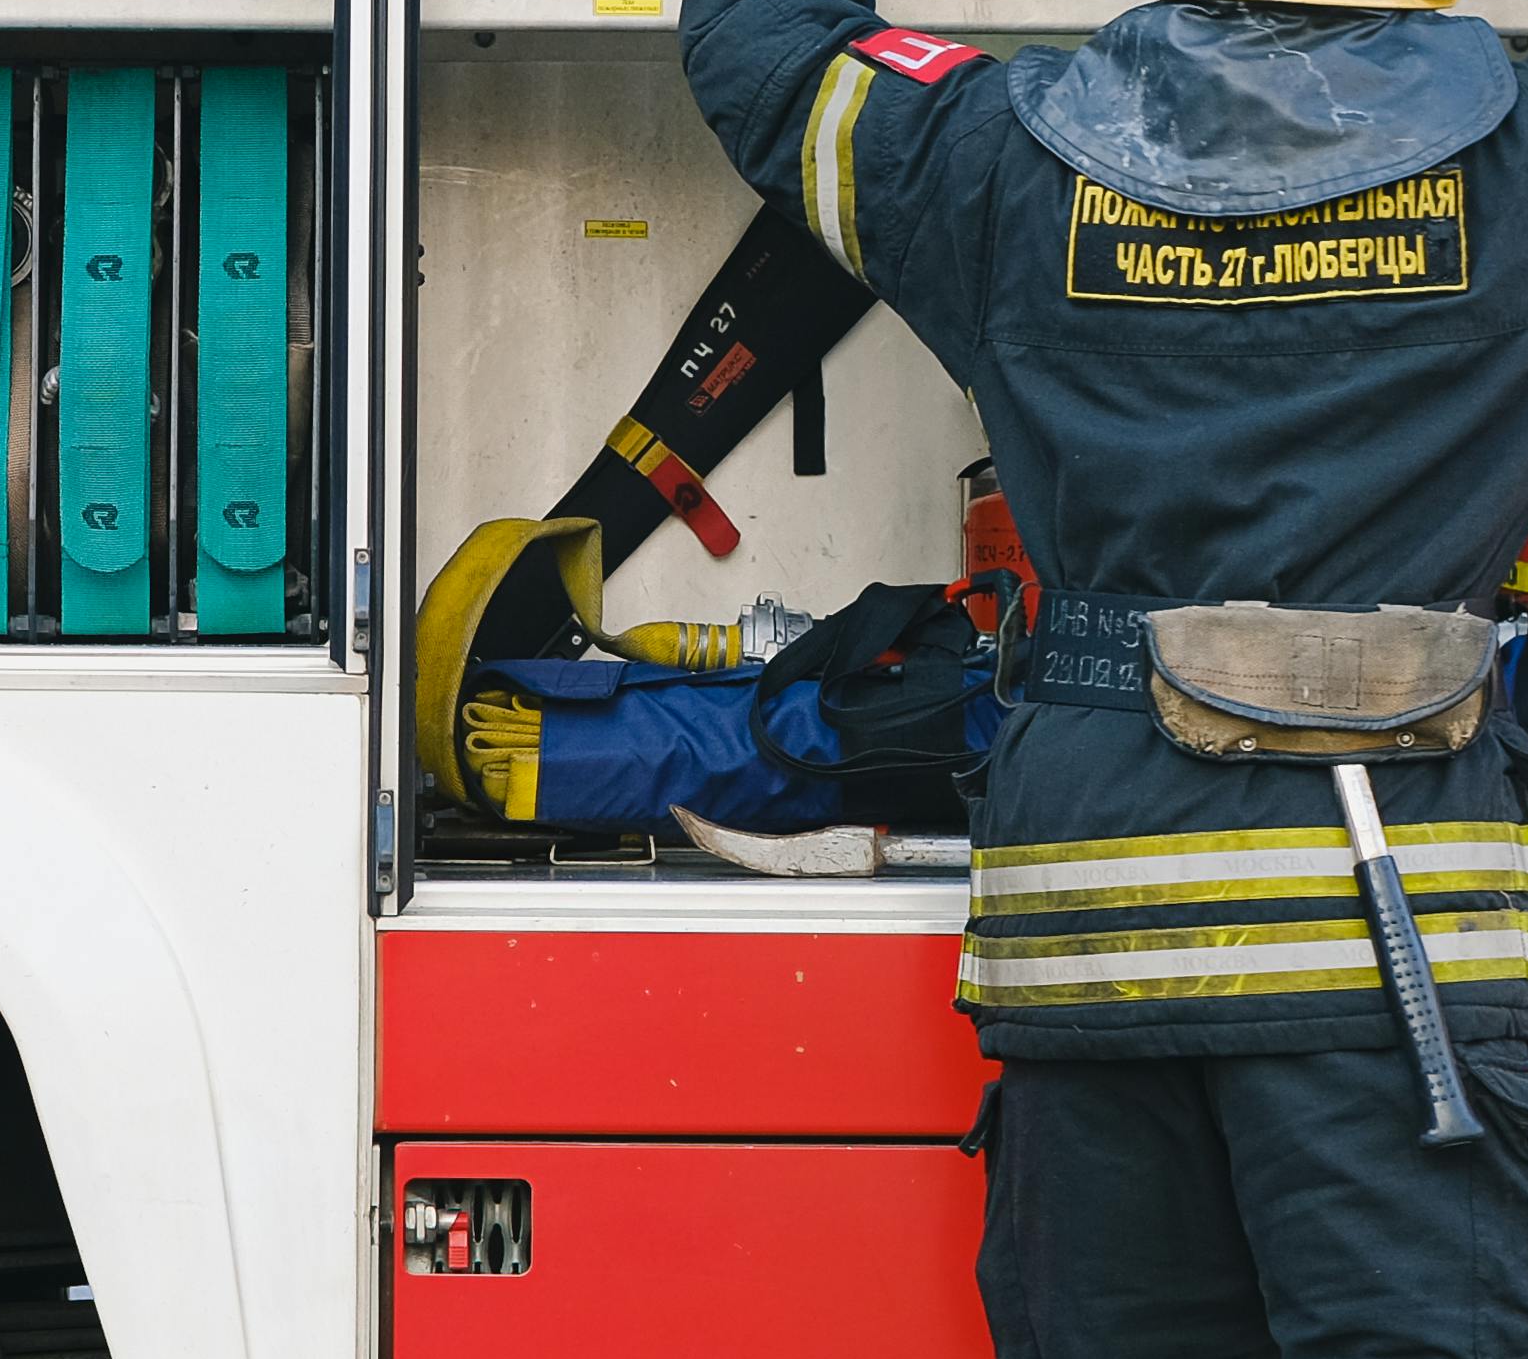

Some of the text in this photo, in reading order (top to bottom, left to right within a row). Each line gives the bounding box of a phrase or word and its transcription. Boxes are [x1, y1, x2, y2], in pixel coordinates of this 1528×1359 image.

[1116, 242, 1214, 287] ЧАСТЬ
[1218, 247, 1247, 288] 27
[1223, 854, 1318, 876] МОСКВА
